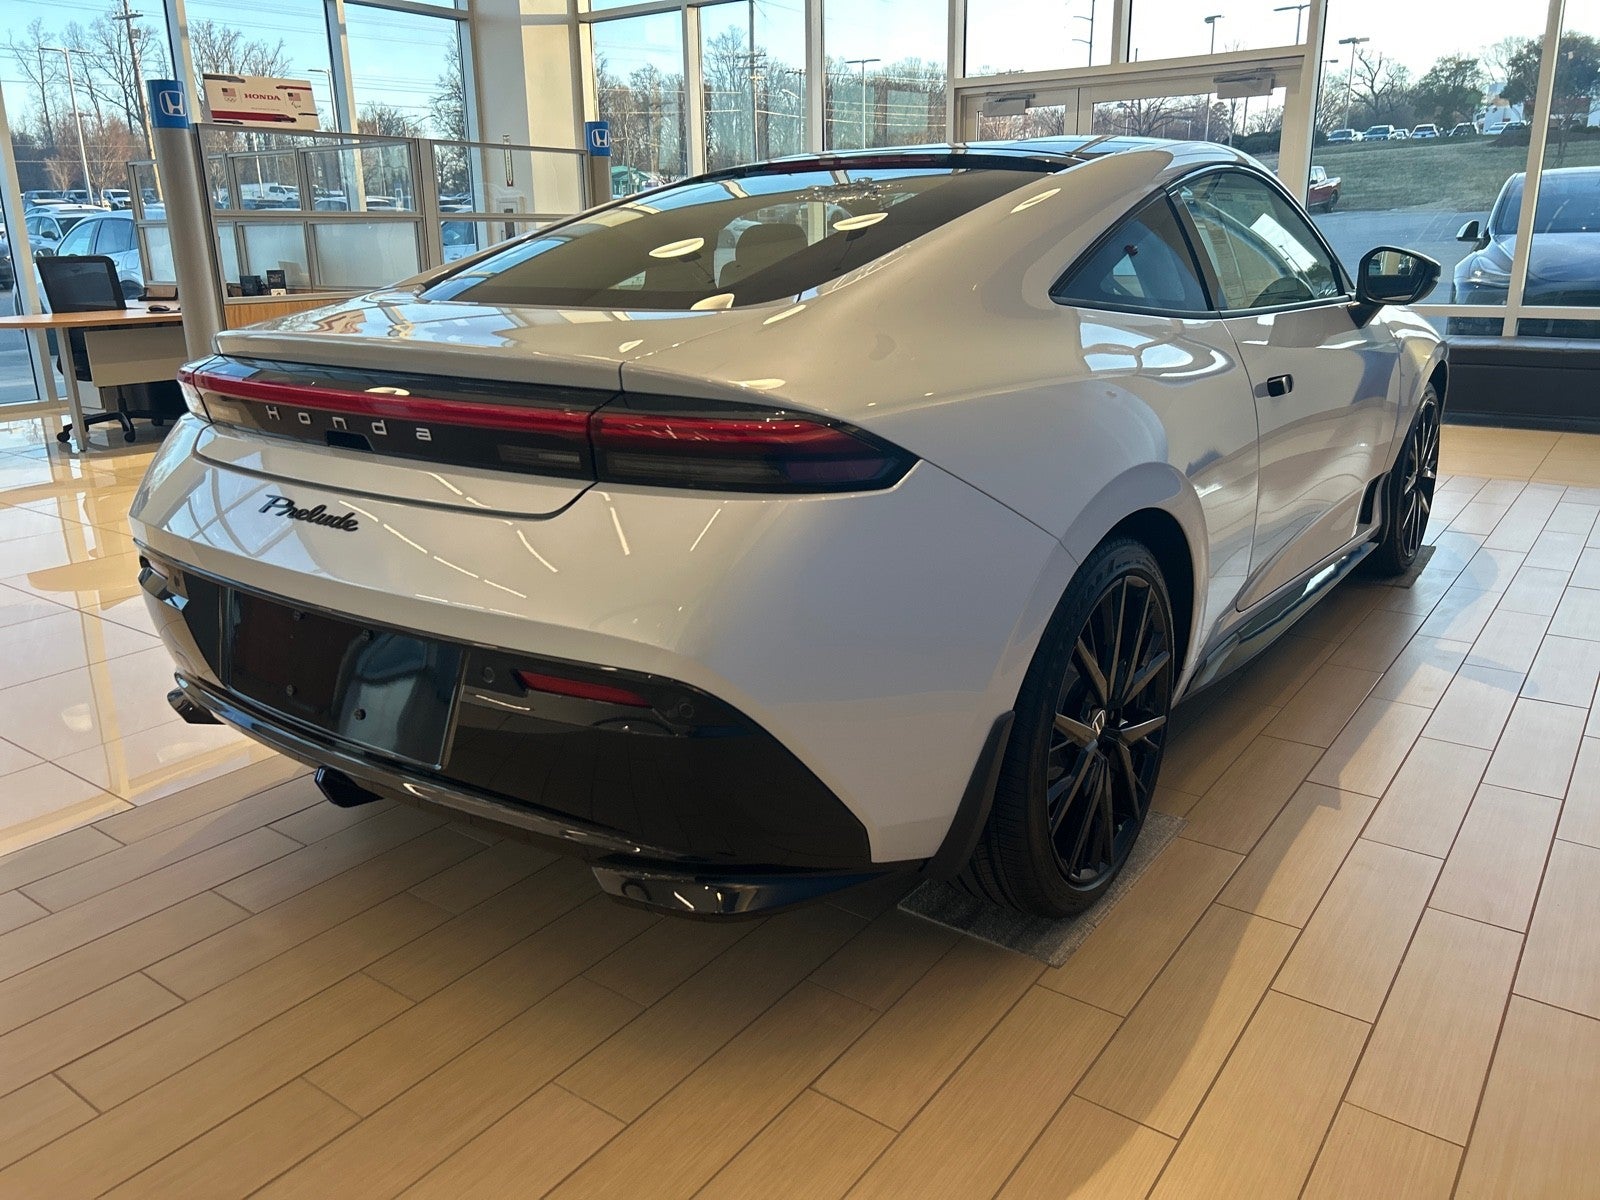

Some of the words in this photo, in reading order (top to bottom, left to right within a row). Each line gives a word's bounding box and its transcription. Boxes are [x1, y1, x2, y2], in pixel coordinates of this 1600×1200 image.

[244, 93, 281, 101] HONDA
[266, 405, 432, 441] Honda
[258, 494, 358, 532] Prelude
